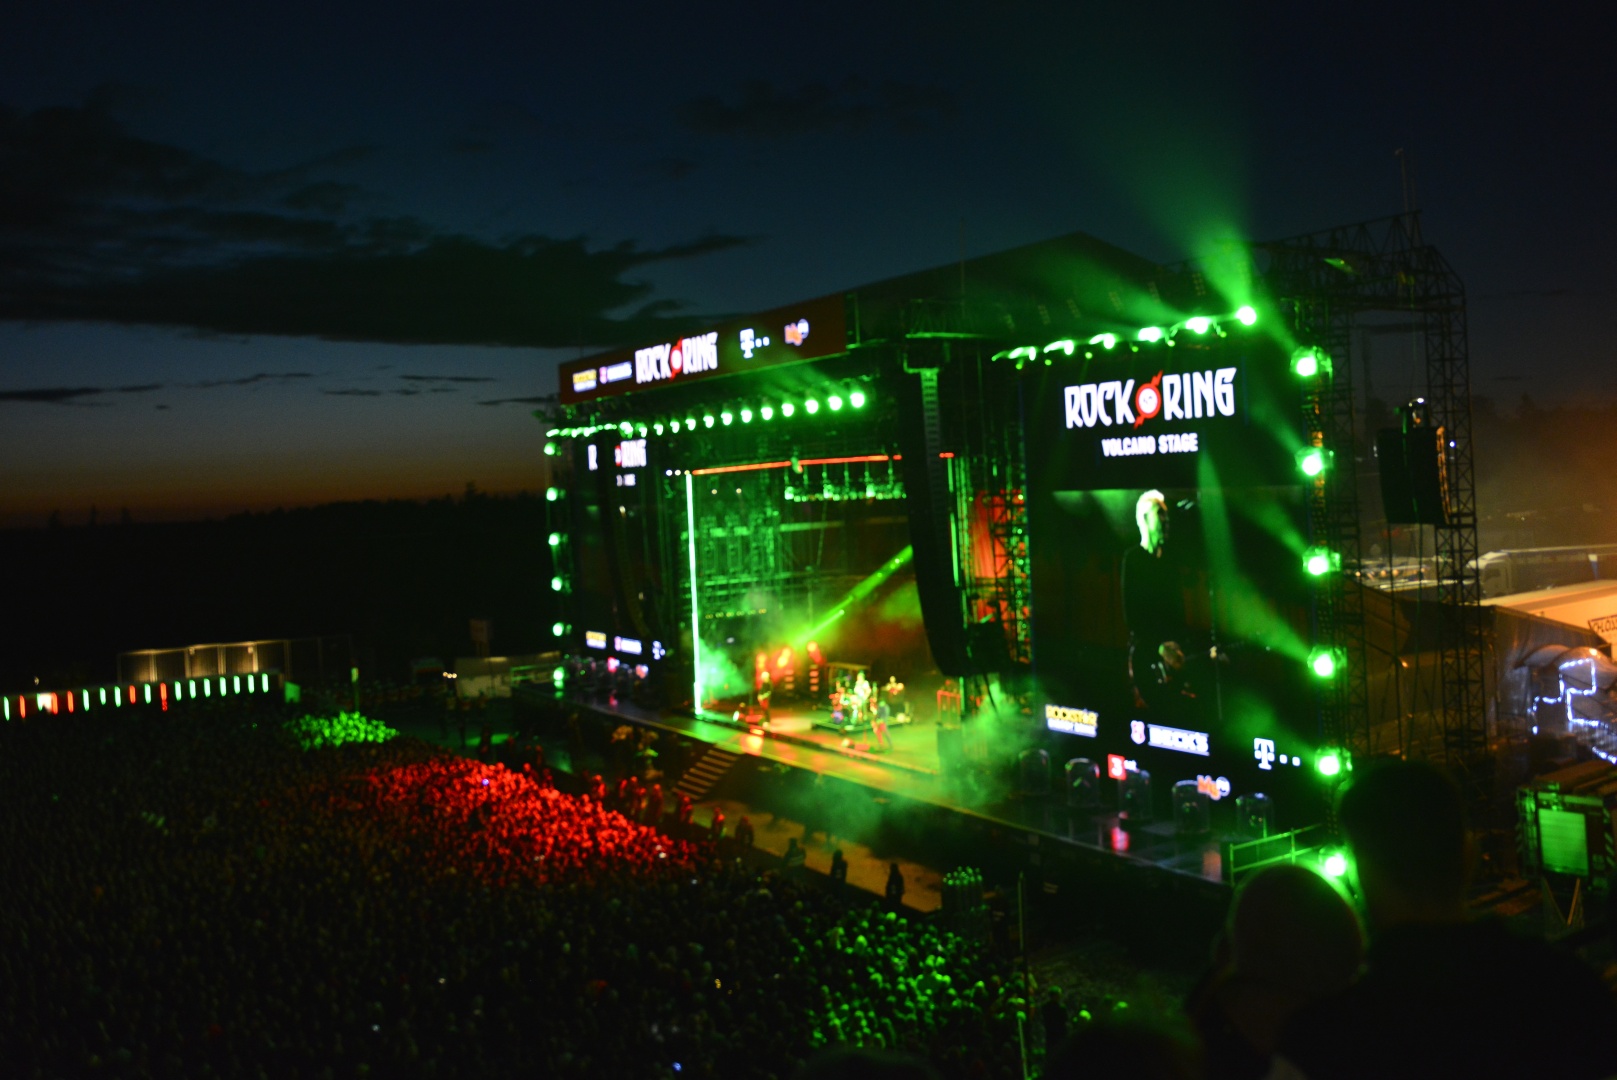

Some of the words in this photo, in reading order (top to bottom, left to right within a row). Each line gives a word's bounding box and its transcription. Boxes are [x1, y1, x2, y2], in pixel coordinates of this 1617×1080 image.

[635, 343, 671, 383] ROCK
[682, 332, 718, 374] RING
[1064, 379, 1136, 429] ROCK
[1162, 367, 1237, 421] RING
[1101, 435, 1156, 457] VOLCANO
[1158, 432, 1198, 454] STAGE
